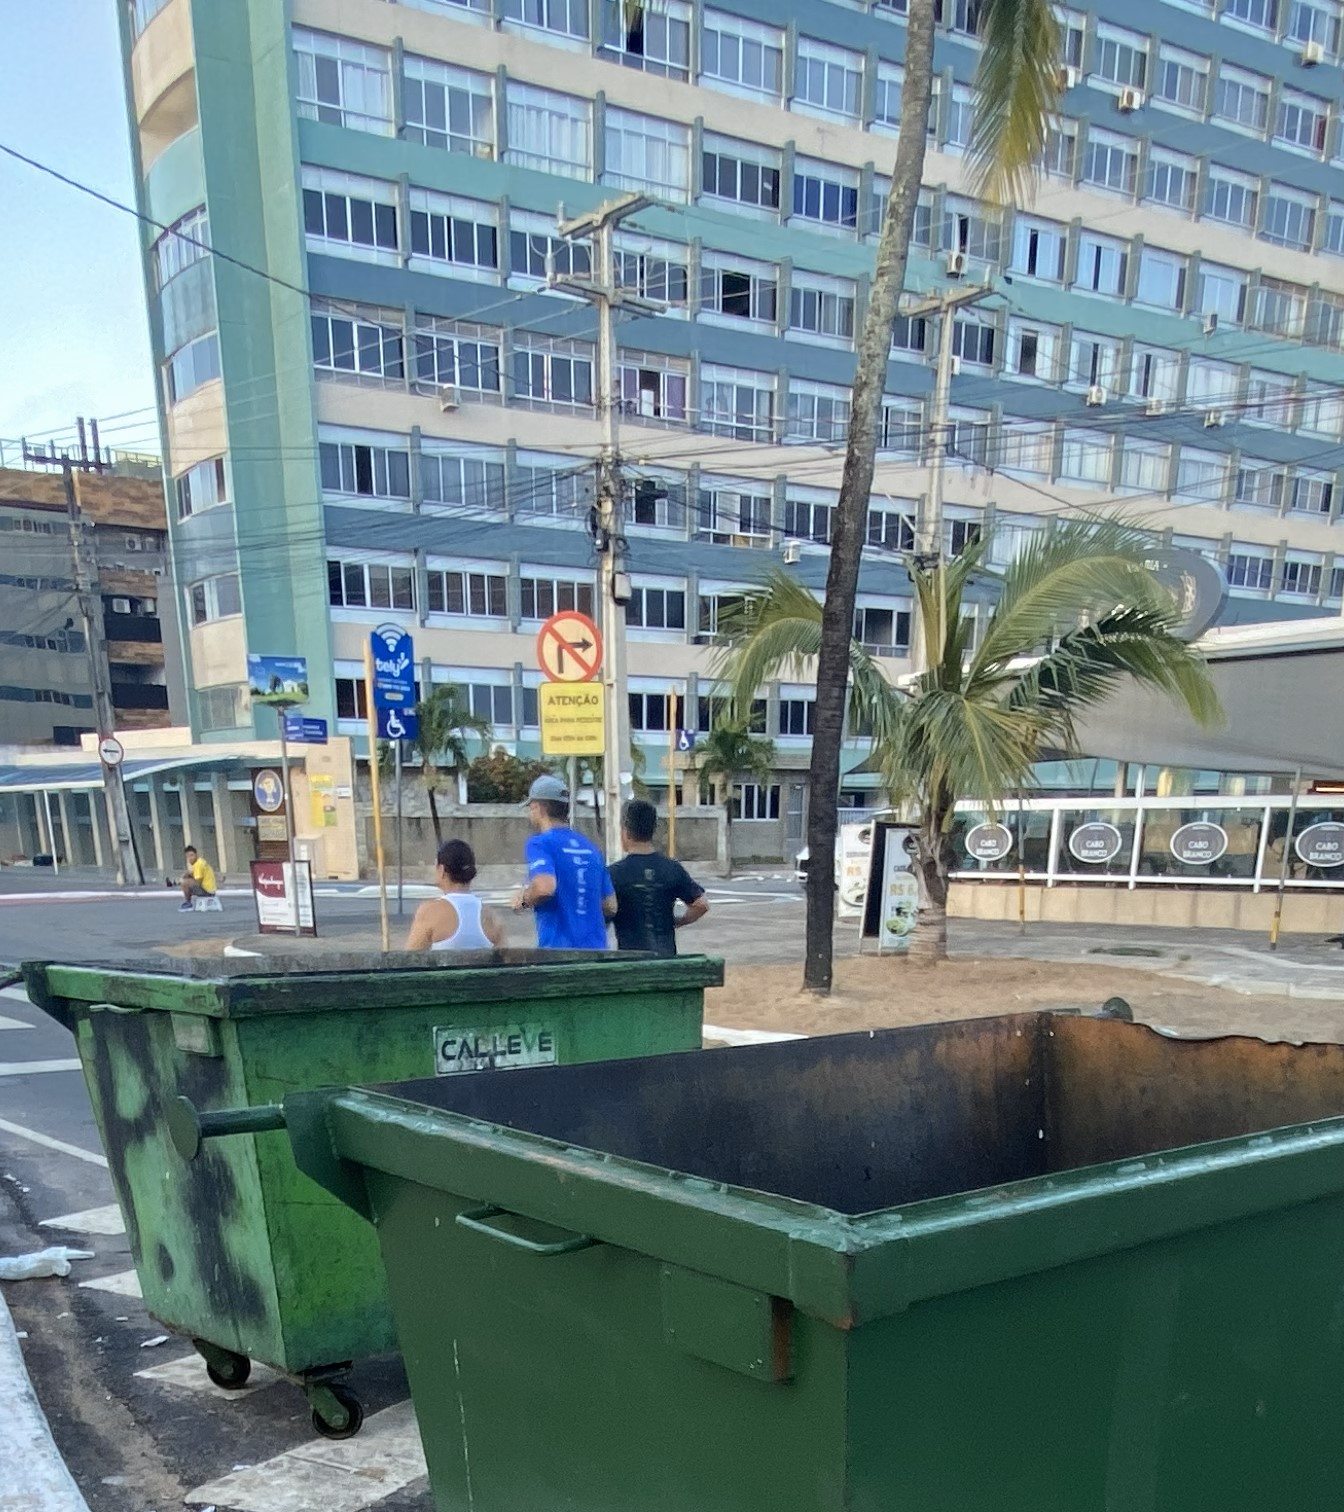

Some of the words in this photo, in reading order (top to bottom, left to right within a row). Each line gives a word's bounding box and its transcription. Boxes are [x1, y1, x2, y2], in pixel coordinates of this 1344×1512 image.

[376, 657, 400, 677] tely
[547, 693, 599, 707] ATENÇÃO
[441, 1032, 553, 1061] CALLEVE
